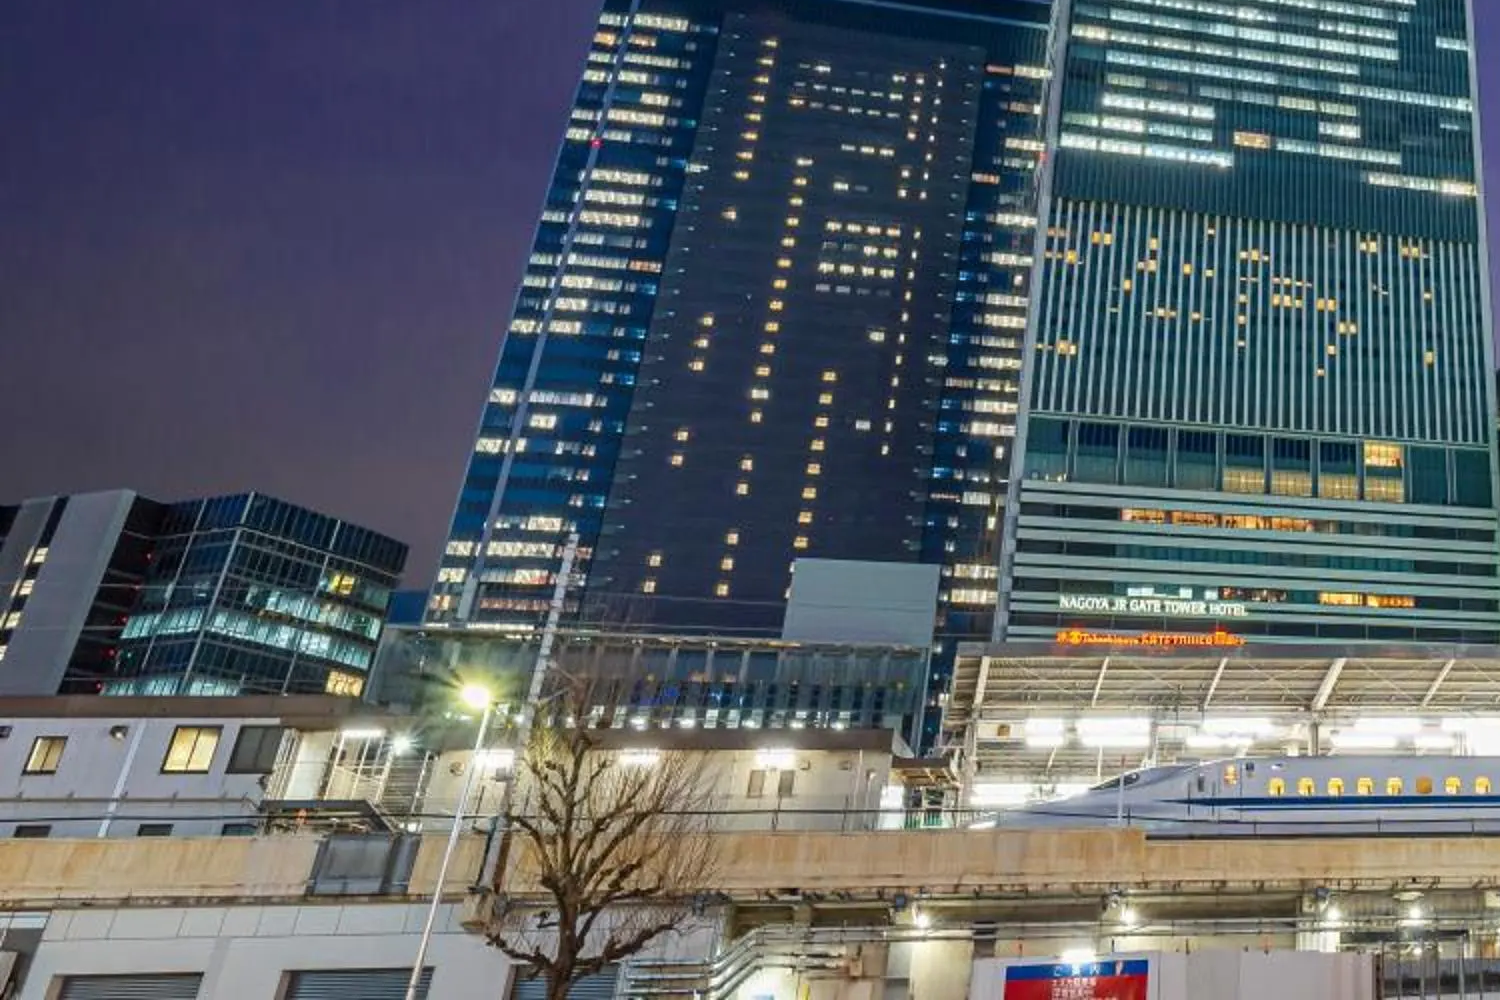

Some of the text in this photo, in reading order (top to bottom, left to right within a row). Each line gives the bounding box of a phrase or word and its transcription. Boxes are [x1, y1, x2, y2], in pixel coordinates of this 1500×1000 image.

[1059, 596, 1249, 616] NAGOYA JR GATE TOWER HOTEL
